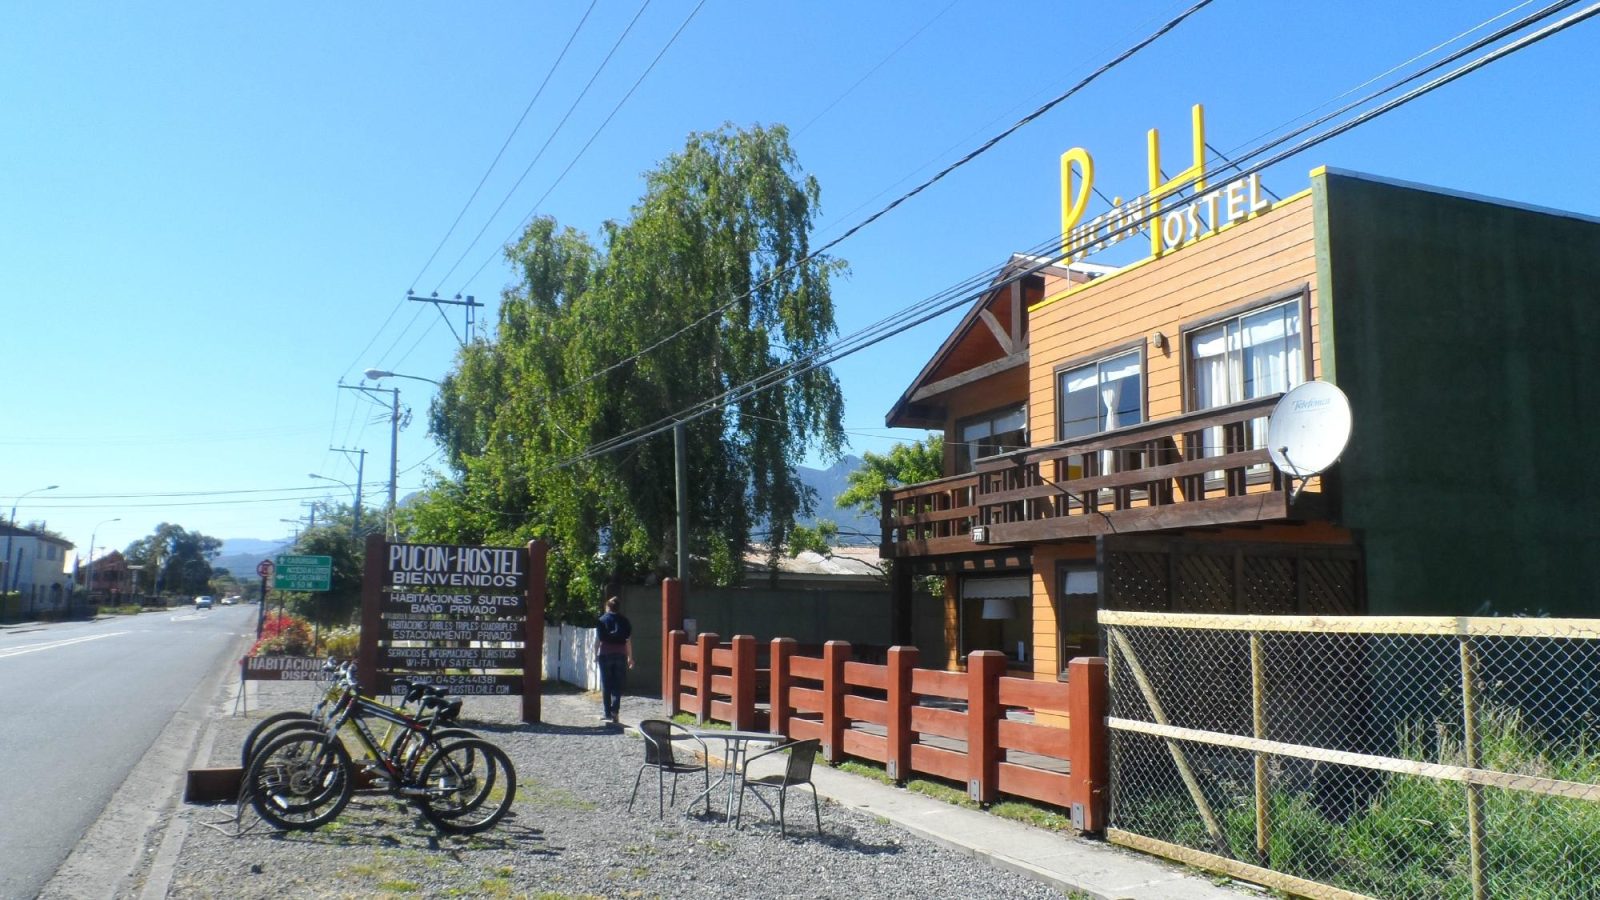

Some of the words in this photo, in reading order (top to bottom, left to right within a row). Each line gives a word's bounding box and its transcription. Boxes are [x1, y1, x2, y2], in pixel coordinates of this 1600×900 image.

[389, 545, 523, 576] PUCON-HOSTEL
[393, 572, 517, 587] BIENVENIDOS
[390, 593, 472, 605] HABITACIONES
[478, 595, 519, 606] SUITES
[411, 603, 443, 614] BAÑO
[450, 605, 497, 615] PRIVADO
[393, 630, 472, 640] ESTACIONAMIENTO
[477, 631, 512, 640] PRIVADO
[248, 657, 321, 671] HABITACION
[406, 658, 430, 667] WI-FI
[434, 658, 447, 667] TV
[449, 658, 499, 668] SATELITAL
